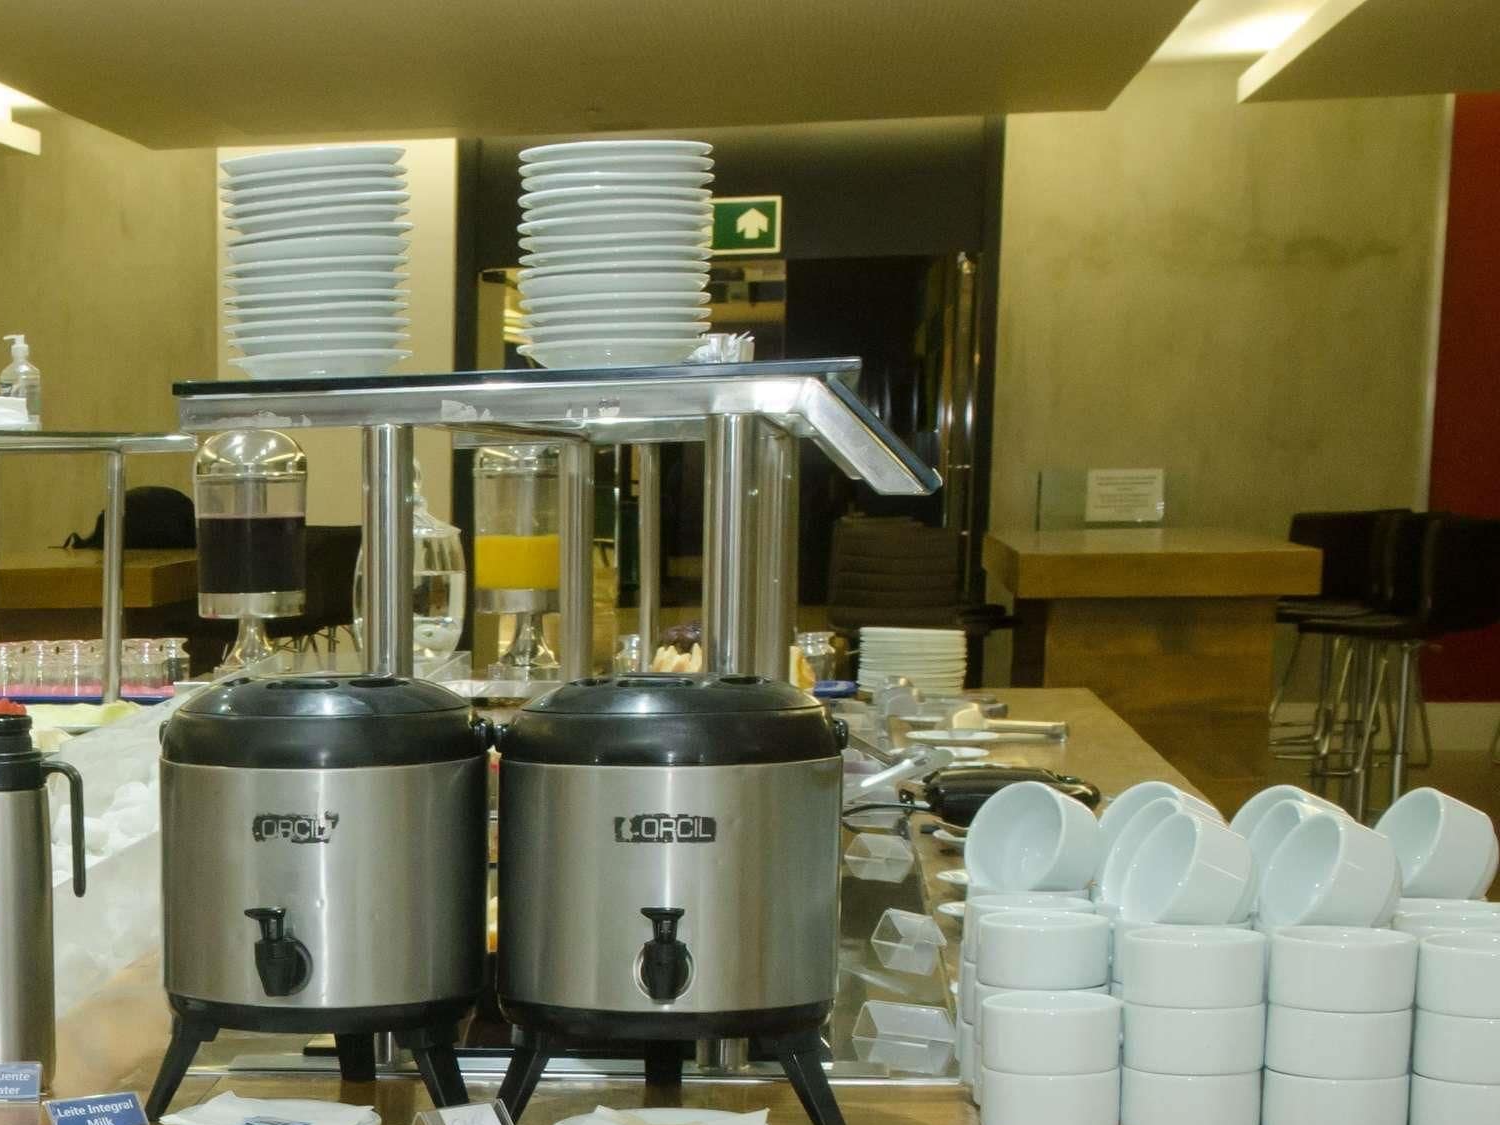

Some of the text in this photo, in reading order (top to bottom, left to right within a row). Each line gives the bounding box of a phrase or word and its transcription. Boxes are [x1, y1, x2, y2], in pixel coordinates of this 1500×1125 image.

[641, 818, 712, 839] ORCIL
[56, 1099, 134, 1118] Leite Integral
